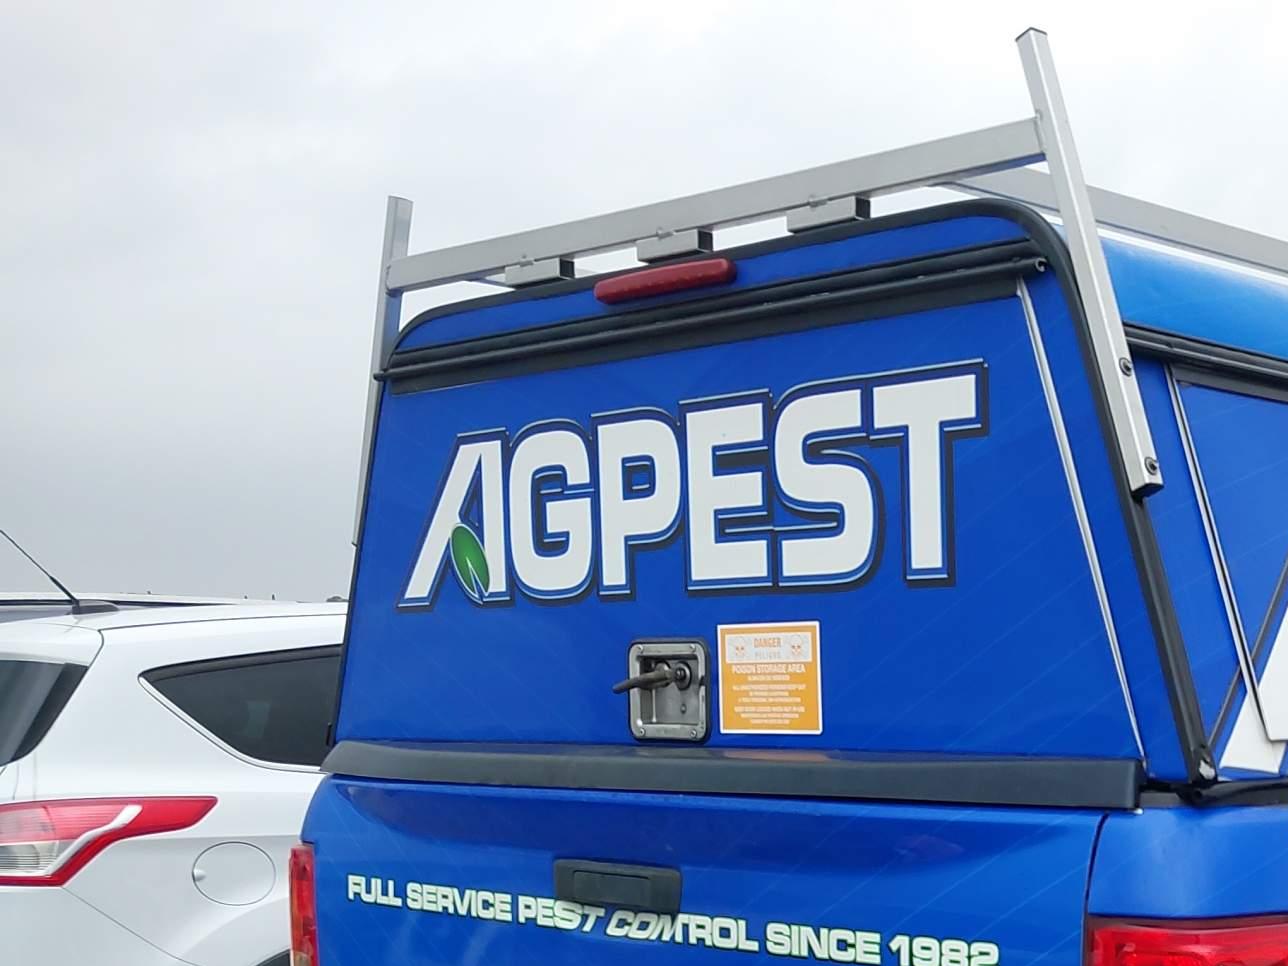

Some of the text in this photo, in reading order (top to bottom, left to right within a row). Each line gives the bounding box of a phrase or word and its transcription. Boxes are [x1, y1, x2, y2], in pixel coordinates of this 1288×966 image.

[392, 360, 989, 612] AGPEST
[753, 637, 782, 648] DANGER
[787, 663, 807, 673] AREA
[347, 874, 402, 907] FULL
[406, 881, 512, 922] SERVICE
[518, 895, 604, 932] PEST
[605, 908, 759, 951] CONTROL
[765, 922, 881, 965] SINCE
